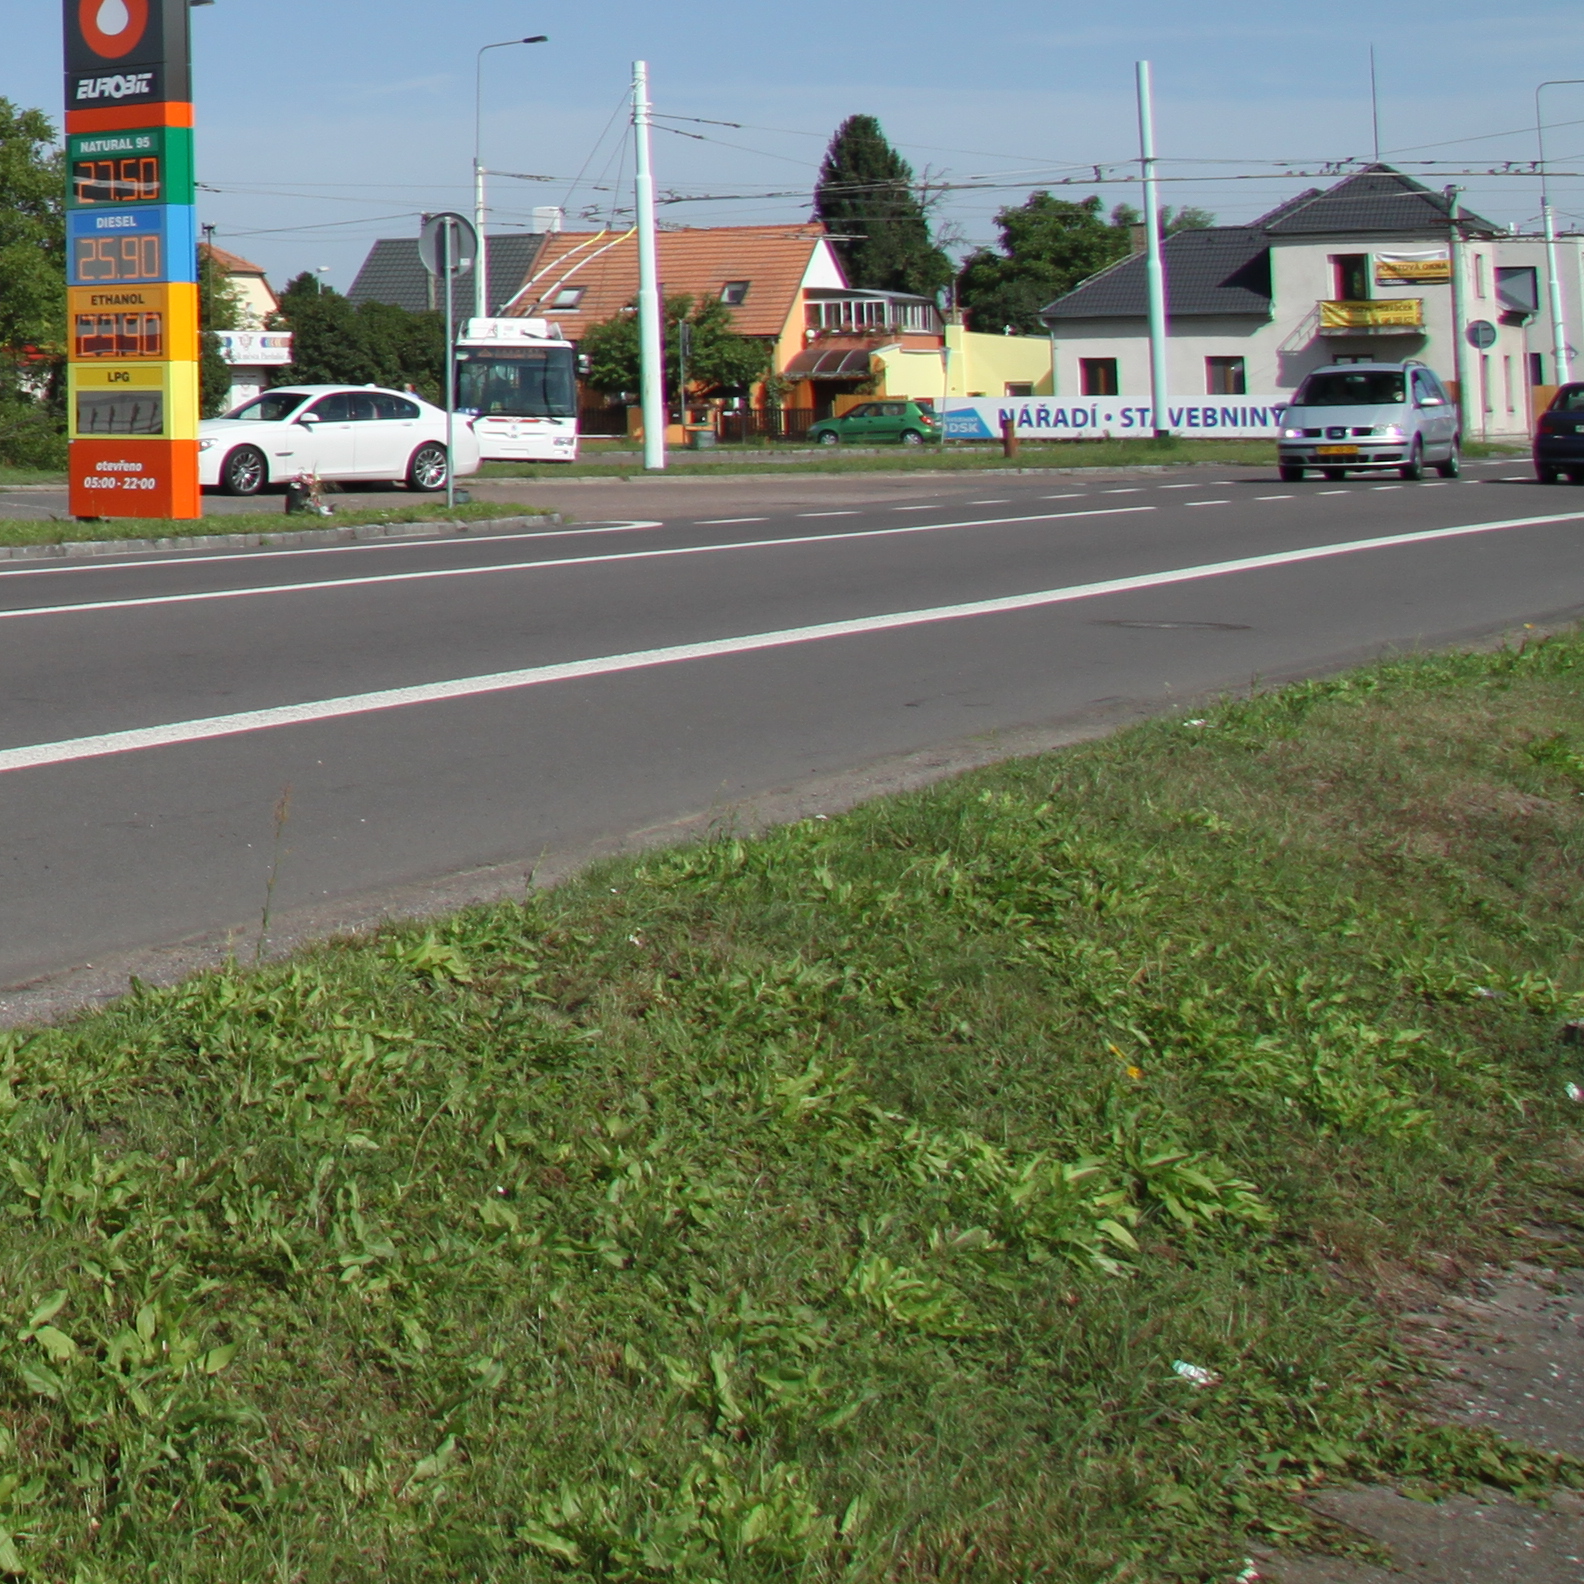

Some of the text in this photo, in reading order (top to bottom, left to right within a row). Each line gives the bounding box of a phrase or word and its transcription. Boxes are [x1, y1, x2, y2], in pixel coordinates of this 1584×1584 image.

[80, 136, 150, 153] NATURAL 95
[96, 215, 138, 229] DIESEL
[79, 236, 159, 280] 25.90
[91, 293, 145, 306] ETHANOL
[107, 371, 130, 383] LPG
[998, 403, 1098, 428] NÁŘADÍ
[96, 460, 142, 471] otevřeno
[84, 476, 116, 488] 05:00
